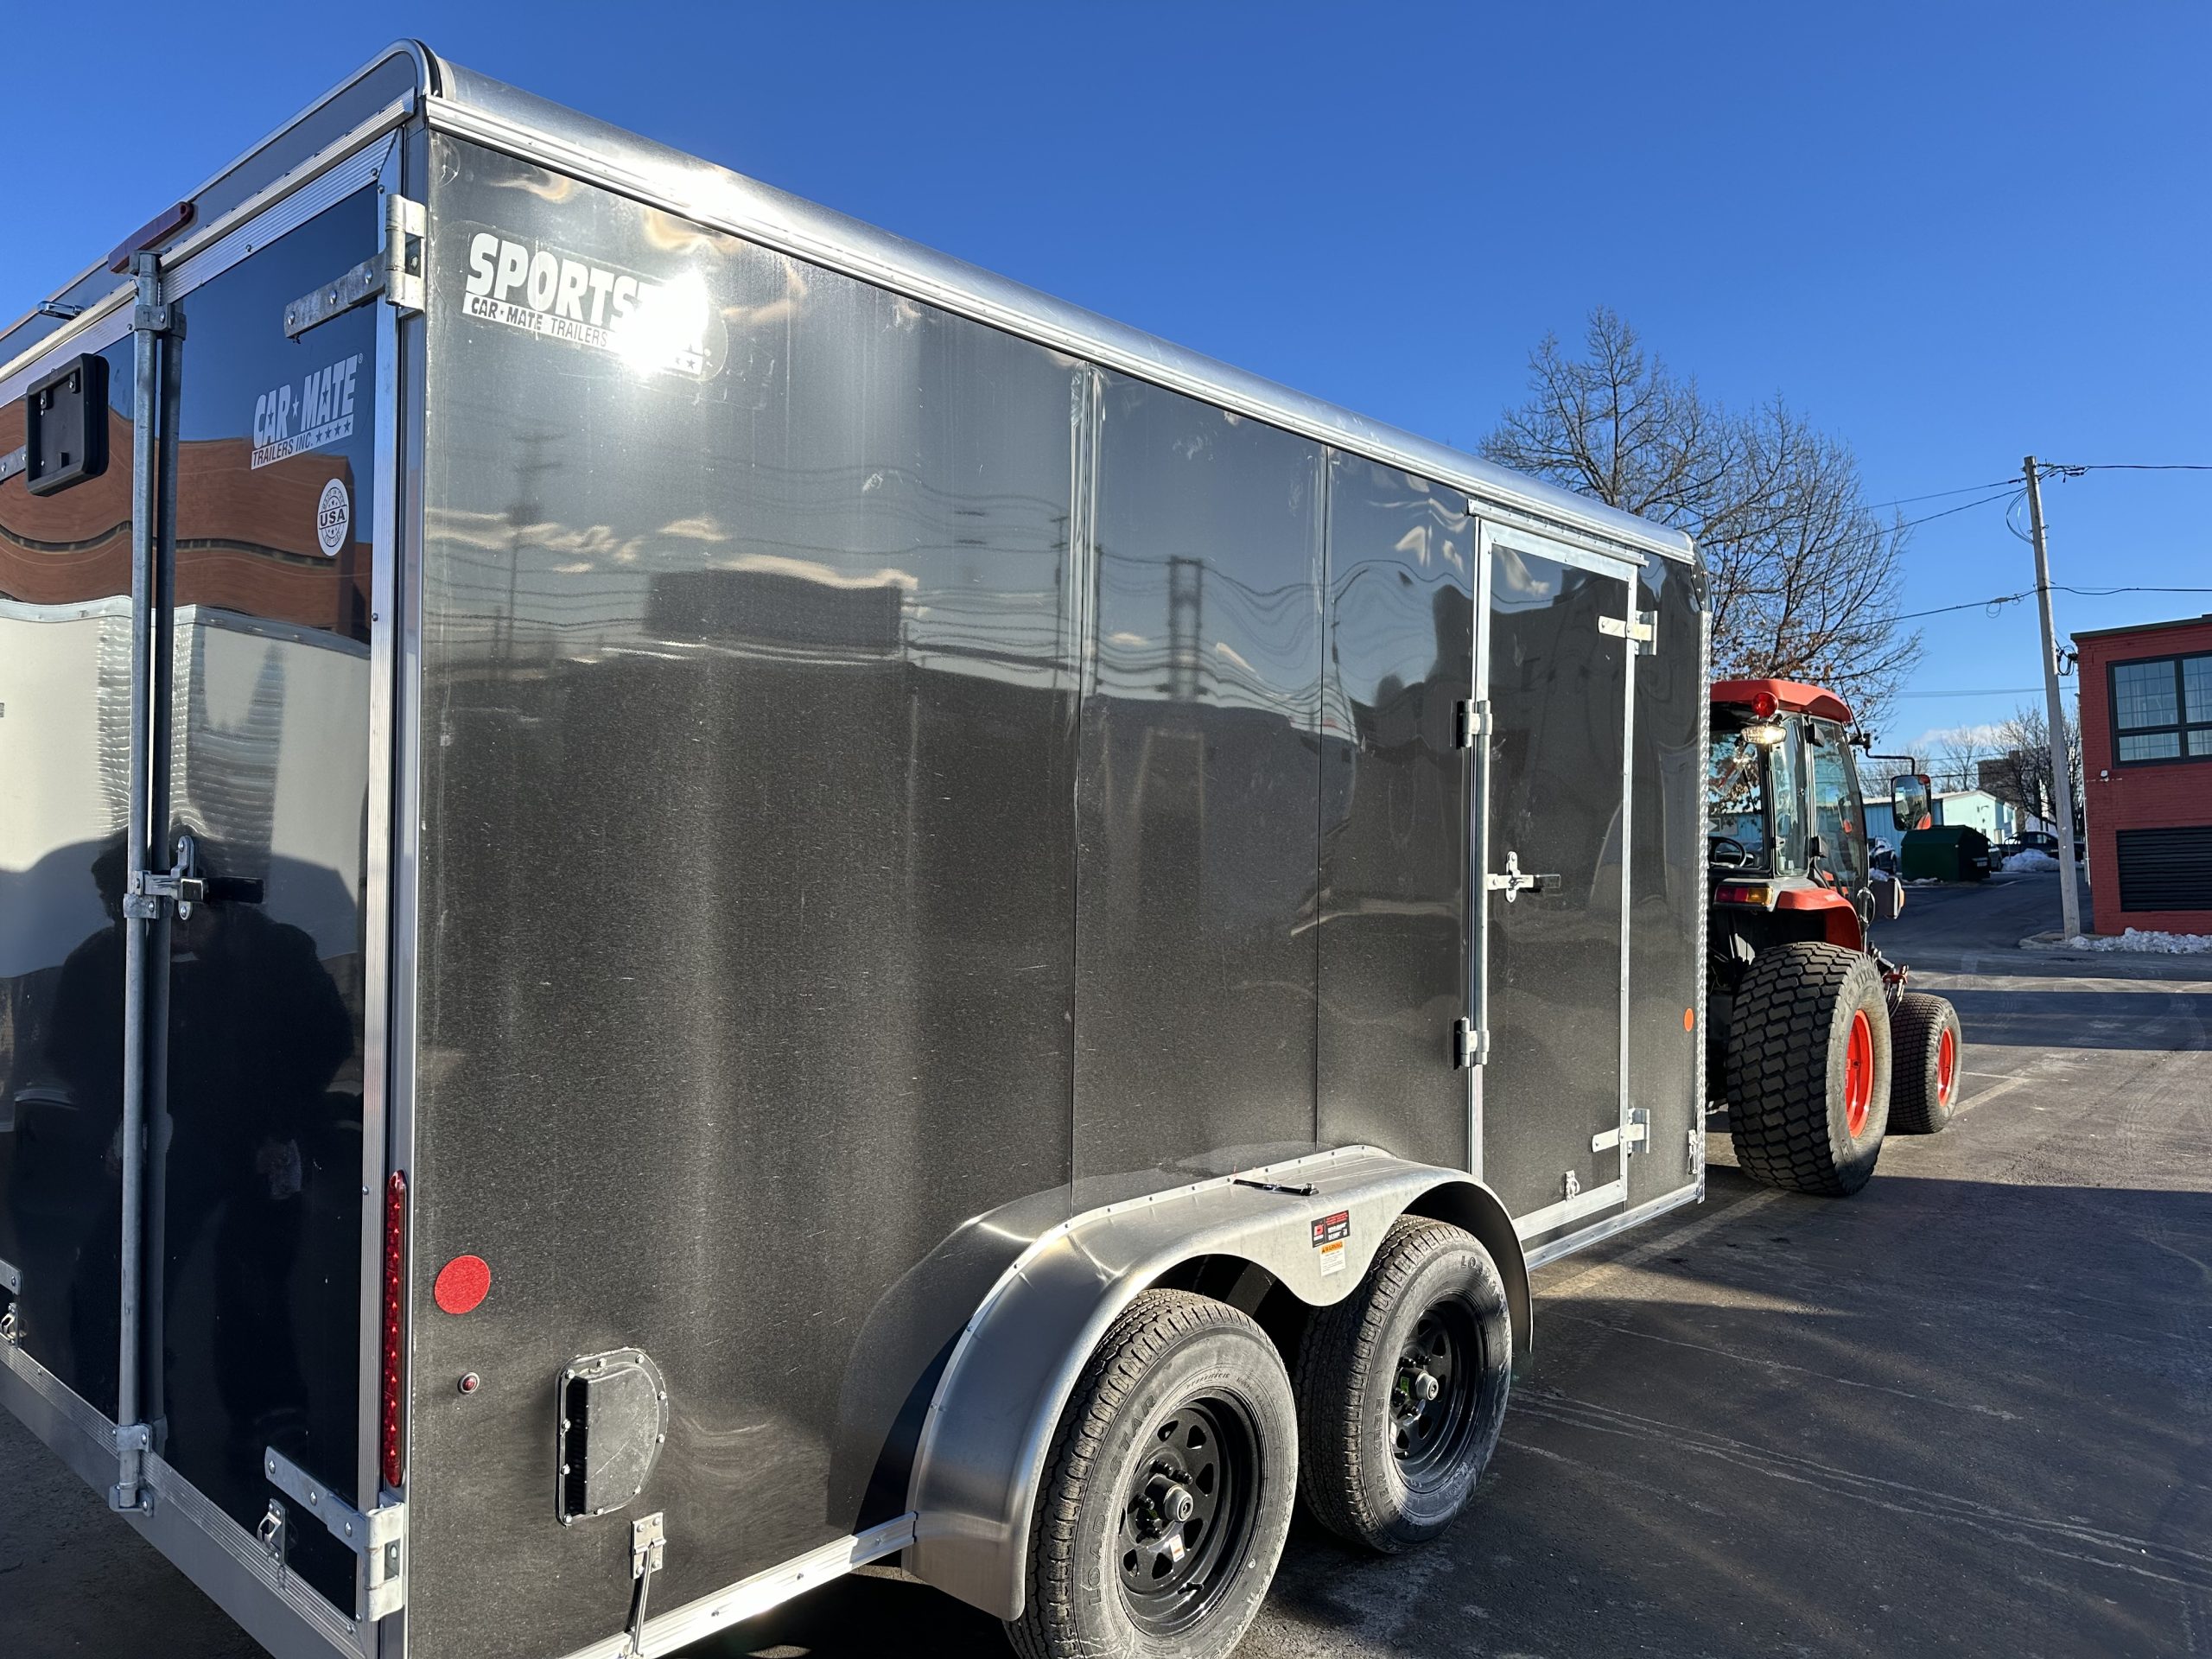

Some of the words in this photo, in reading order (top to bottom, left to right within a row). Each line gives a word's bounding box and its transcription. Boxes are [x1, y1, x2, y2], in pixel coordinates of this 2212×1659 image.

[466, 232, 661, 336] SPORTS
[471, 296, 499, 320] CAR
[505, 306, 543, 331] MATE
[550, 317, 607, 347] TRAILERS
[253, 384, 292, 450] CAR
[300, 353, 359, 432] MATE
[252, 438, 295, 468] TRAILERS
[295, 431, 315, 453] INC.
[320, 508, 346, 527] USA
